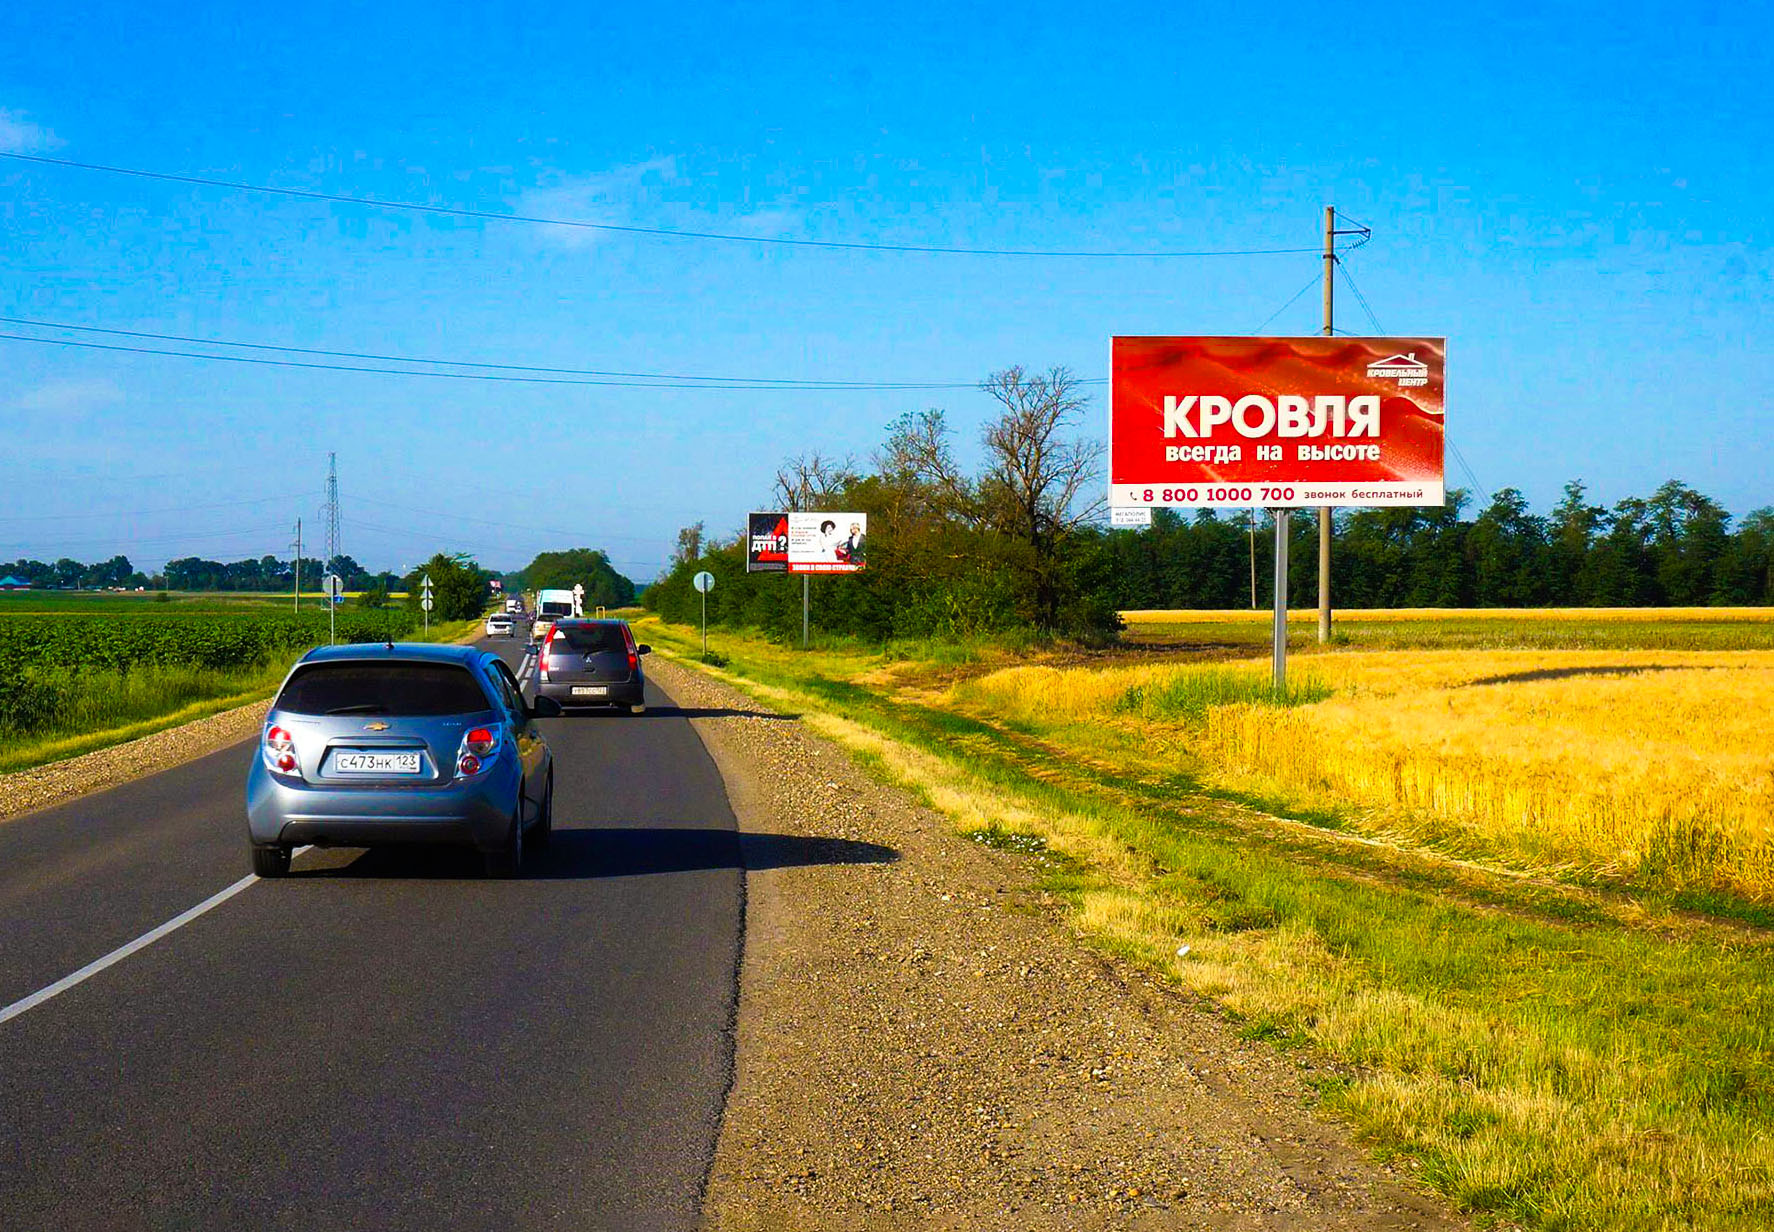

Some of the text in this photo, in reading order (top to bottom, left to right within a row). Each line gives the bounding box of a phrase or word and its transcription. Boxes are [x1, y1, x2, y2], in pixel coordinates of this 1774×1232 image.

[1366, 367, 1428, 378] КРОВЕЛЬНЫЙ
[1397, 378, 1428, 387] ЦЕНТР
[1163, 394, 1380, 438] КРОВЛЯ
[1166, 445, 1380, 464] всегда на высоте
[1142, 487, 1423, 502] 8 800 1000 700 звонок бесплатный
[396, 755, 416, 766] 123
